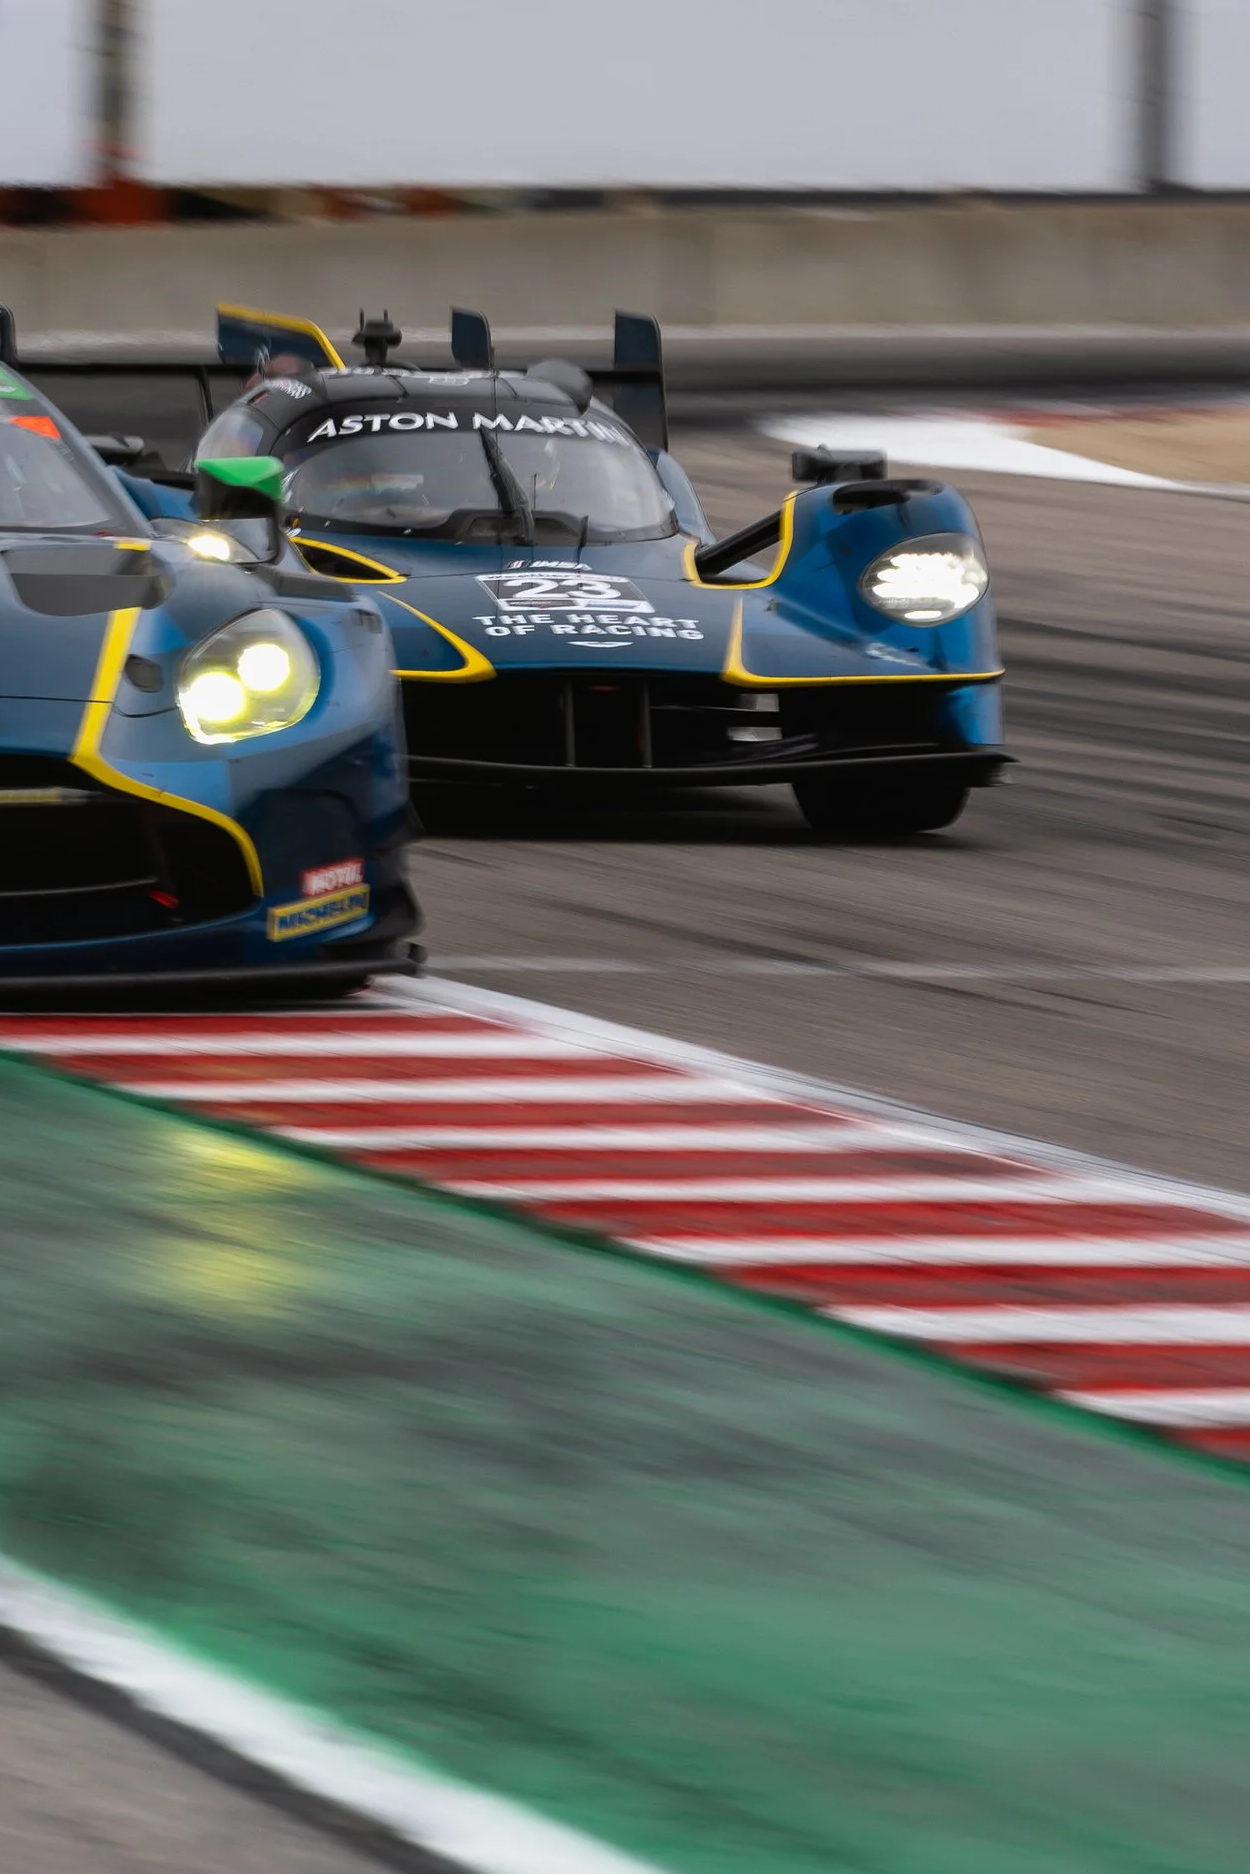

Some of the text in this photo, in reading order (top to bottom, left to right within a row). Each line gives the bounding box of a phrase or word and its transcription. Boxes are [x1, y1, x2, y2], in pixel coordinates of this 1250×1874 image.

[306, 411, 629, 445] ASTON MARTIN
[503, 579, 622, 600] 23
[472, 614, 700, 629] THE HEART
[484, 625, 704, 640] OF RACING
